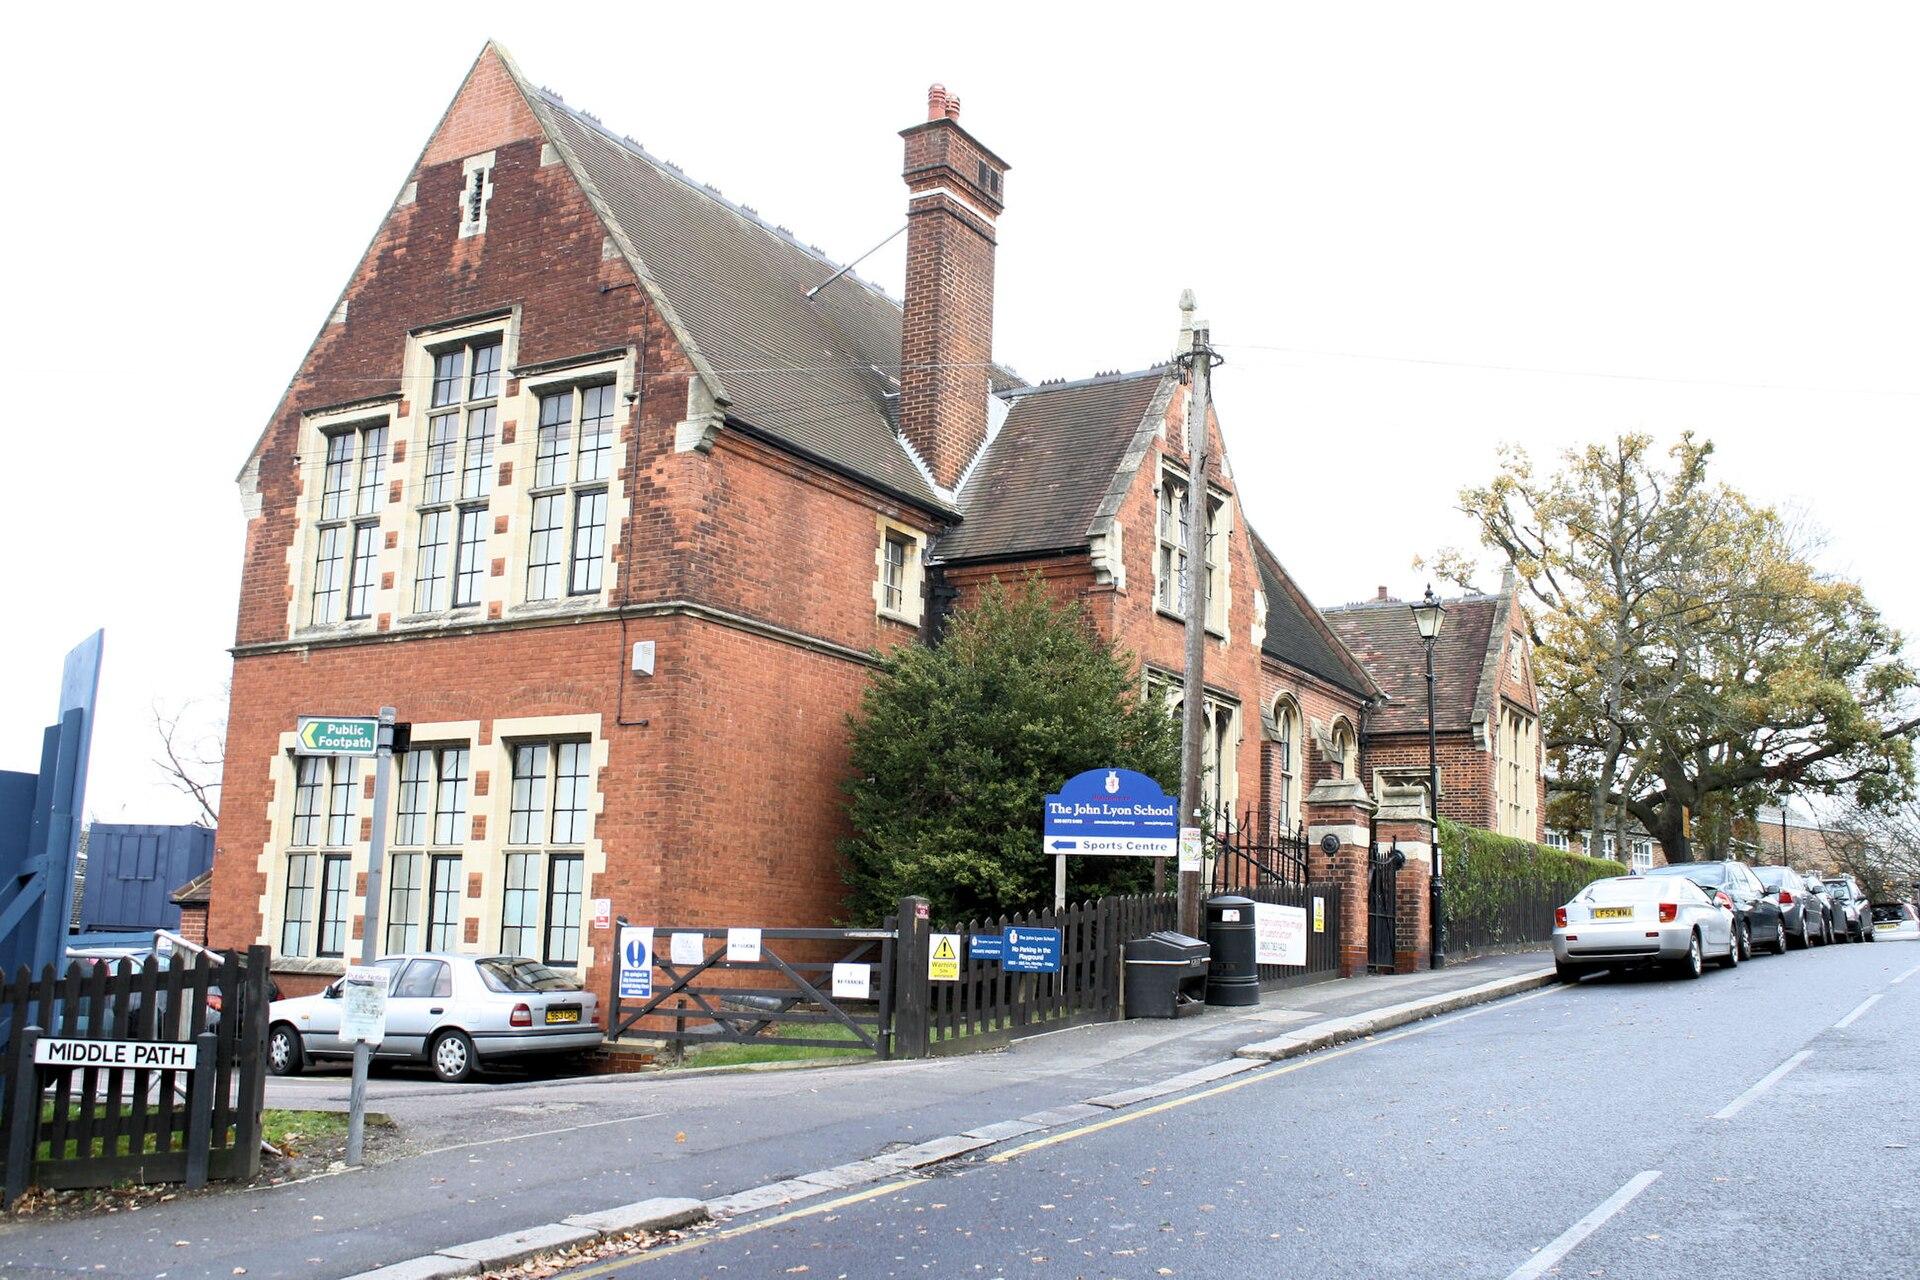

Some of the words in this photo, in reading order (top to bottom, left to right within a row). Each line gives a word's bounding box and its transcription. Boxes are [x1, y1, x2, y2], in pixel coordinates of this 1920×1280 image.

[327, 724, 364, 735] Public
[318, 736, 371, 749] Footpath
[1049, 803, 1072, 814] The
[1073, 803, 1100, 816] John
[1102, 804, 1132, 817] Lyon
[1133, 804, 1173, 816] School
[1083, 841, 1123, 851] Sports
[1126, 841, 1168, 851] Centre
[1019, 946, 1037, 954] Parking
[931, 961, 957, 969] Warning
[49, 1042, 126, 1062] MIDDLE
[134, 1045, 186, 1065] PATH
